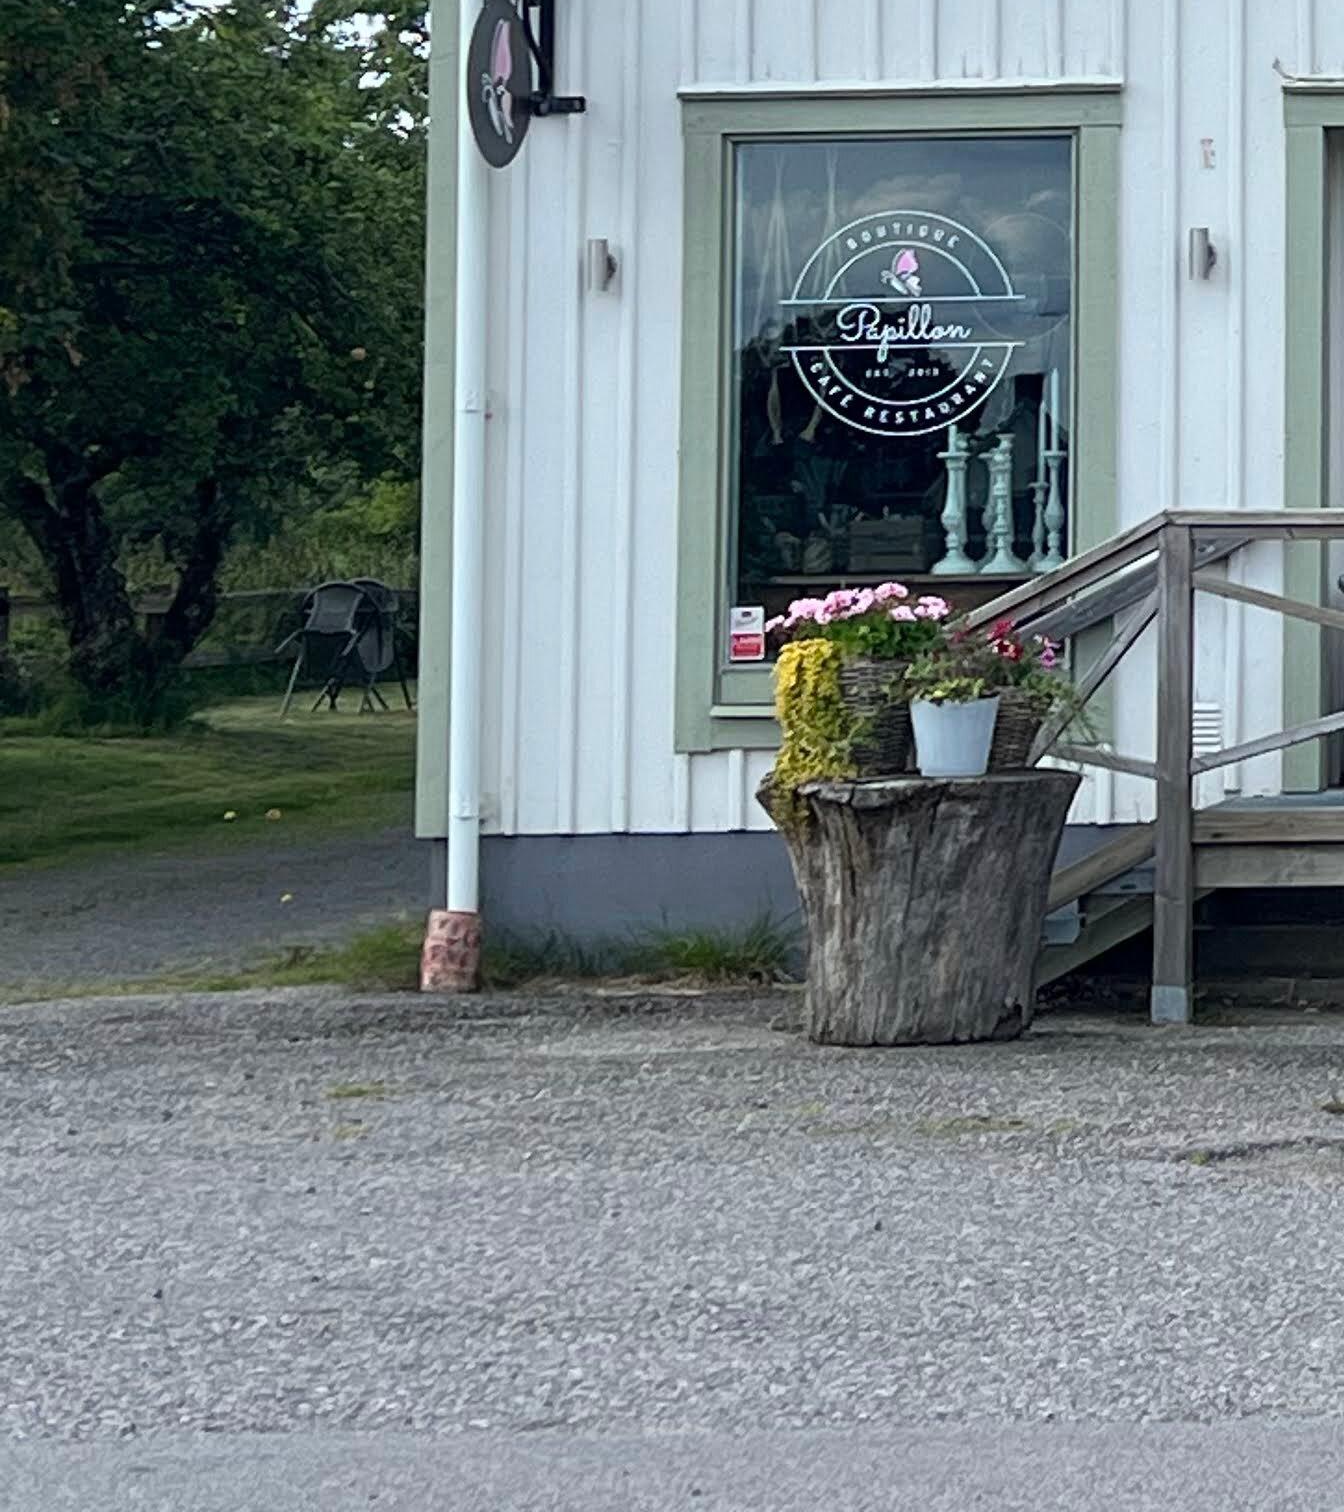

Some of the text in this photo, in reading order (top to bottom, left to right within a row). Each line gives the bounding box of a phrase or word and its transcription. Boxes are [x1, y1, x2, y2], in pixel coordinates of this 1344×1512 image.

[847, 223, 960, 250] BOUTIQUE
[836, 303, 972, 363] Papillon
[863, 358, 993, 424] RESTAURANT
